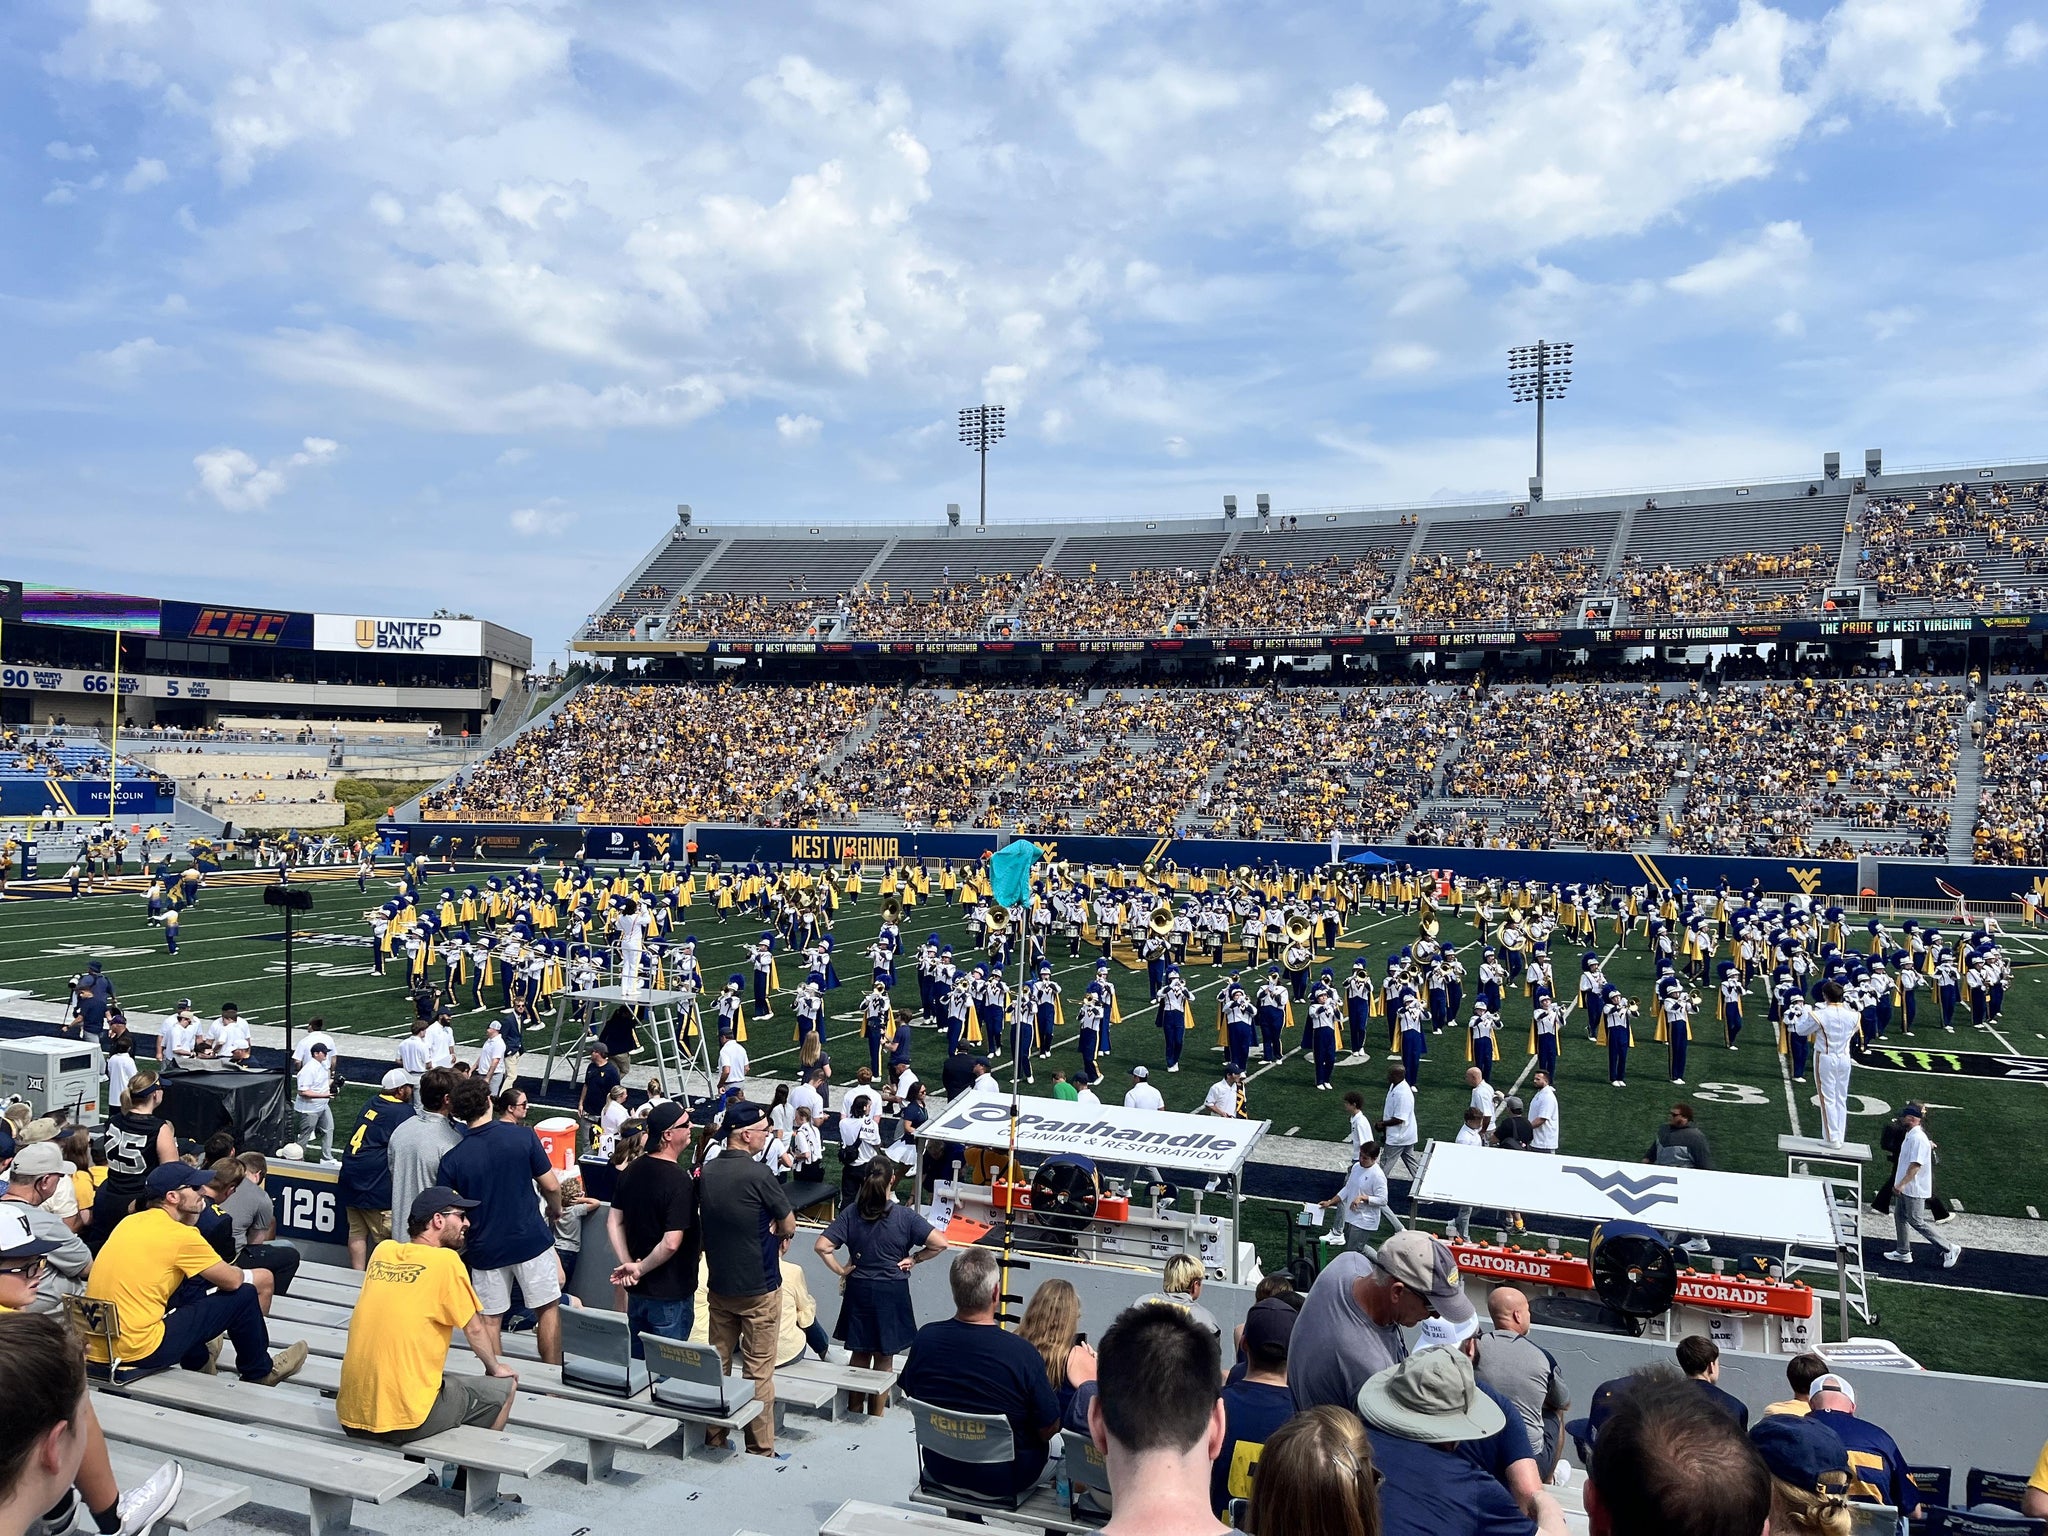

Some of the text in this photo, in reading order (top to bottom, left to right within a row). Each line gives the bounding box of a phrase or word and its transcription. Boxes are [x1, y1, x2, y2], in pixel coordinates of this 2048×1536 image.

[377, 621, 442, 637] UNITED
[1595, 626, 1729, 642] THE PRIDE OF WEST VIRGINIA
[1820, 618, 1972, 634] THE PRIDE OF WEST VIRGINIA
[377, 635, 424, 650] BANK
[1041, 642, 1054, 652] THE
[1080, 642, 1088, 652] OF
[1091, 642, 1110, 652] WEST
[1112, 642, 1144, 651] VIRGINIA
[1212, 640, 1226, 650] THE
[1253, 639, 1262, 649] OF
[1265, 638, 1284, 648] WEST
[1288, 638, 1322, 648] VIRGINIA
[1395, 636, 1410, 646] THE
[1440, 635, 1450, 646] OF
[1453, 634, 1474, 645] WEST
[1478, 633, 1516, 644] VIRGINIA
[718, 643, 730, 653] THE
[755, 643, 764, 653] OF
[766, 643, 784, 653] WEST
[786, 643, 816, 653] VIRGINIA
[878, 643, 890, 653] THE
[915, 643, 924, 653] OF
[926, 643, 944, 653] WEST
[946, 643, 978, 653] VIRGINIA
[2, 669, 29, 688] 90
[35, 677, 63, 687] TALLEY
[83, 675, 108, 692] 66
[110, 683, 140, 691] HWLEY
[166, 680, 179, 696] 5
[187, 687, 210, 695] WHITE
[91, 792, 144, 800] NEMACOLIN
[159, 782, 175, 796] 25
[456, 812, 521, 820] MOUNTAINEER MANIACS
[608, 814, 638, 822] MOUNTAIN
[792, 836, 899, 860] WEST VIRGINIA
[350, 1124, 368, 1155] 4
[1015, 1113, 1237, 1152] Panhandle
[104, 1124, 147, 1175] 25
[1084, 1136, 1098, 1145] &
[1104, 1140, 1224, 1162] RESTORATION
[282, 1186, 336, 1232] 126
[1458, 1253, 1551, 1278] GATORADE
[1676, 1282, 1768, 1306] ATORADE
[658, 1344, 701, 1362] RENTED
[930, 1413, 986, 1433] RENTED
[958, 1432, 986, 1440] STADIUM
